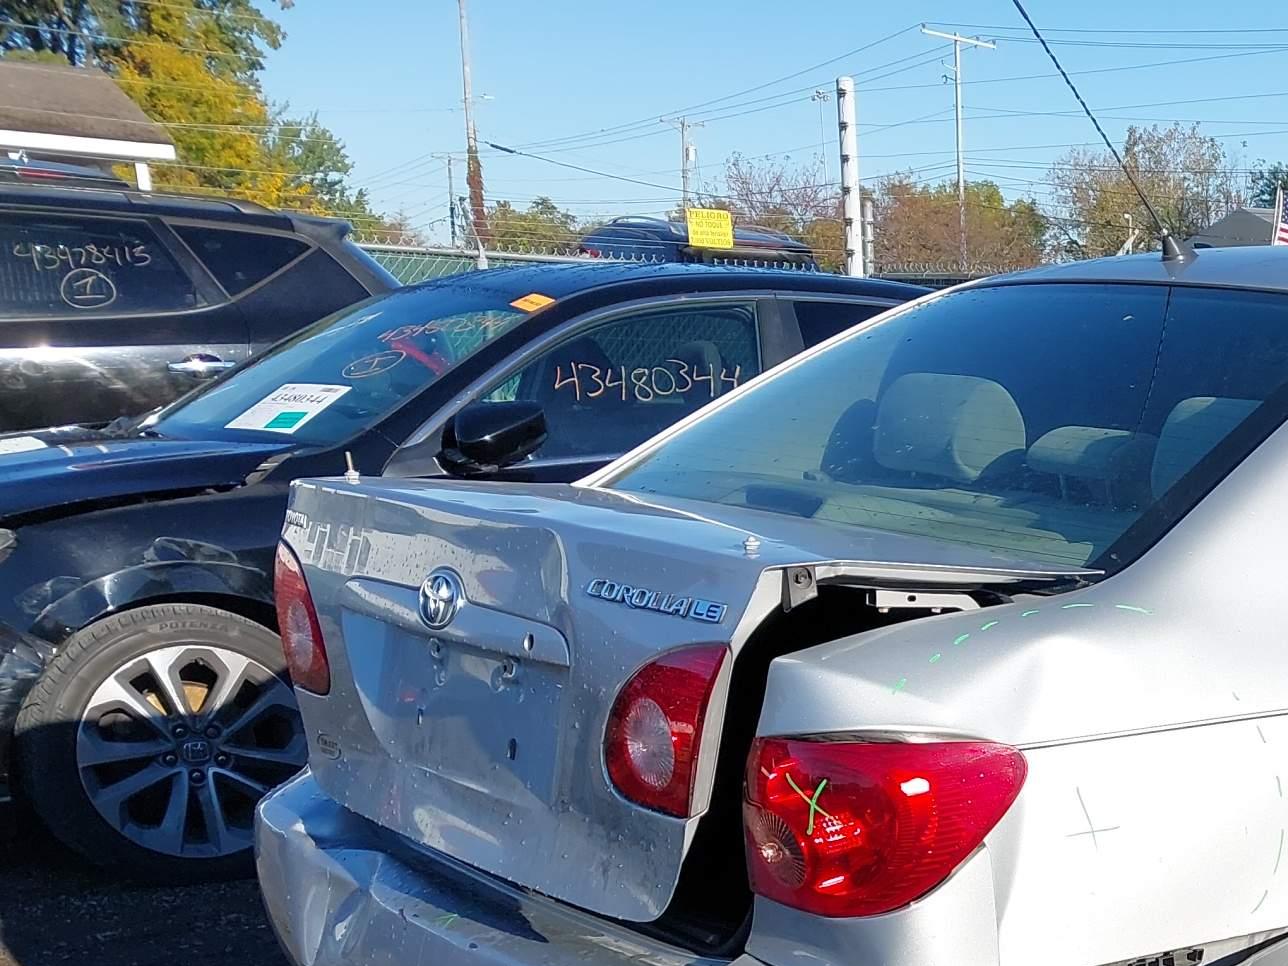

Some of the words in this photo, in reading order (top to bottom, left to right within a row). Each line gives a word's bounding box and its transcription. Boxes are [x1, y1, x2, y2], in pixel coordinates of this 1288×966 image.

[13, 243, 151, 271] 43478415
[554, 361, 741, 401] 43480344
[587, 578, 691, 617] COROLLA
[692, 600, 725, 621] LE
